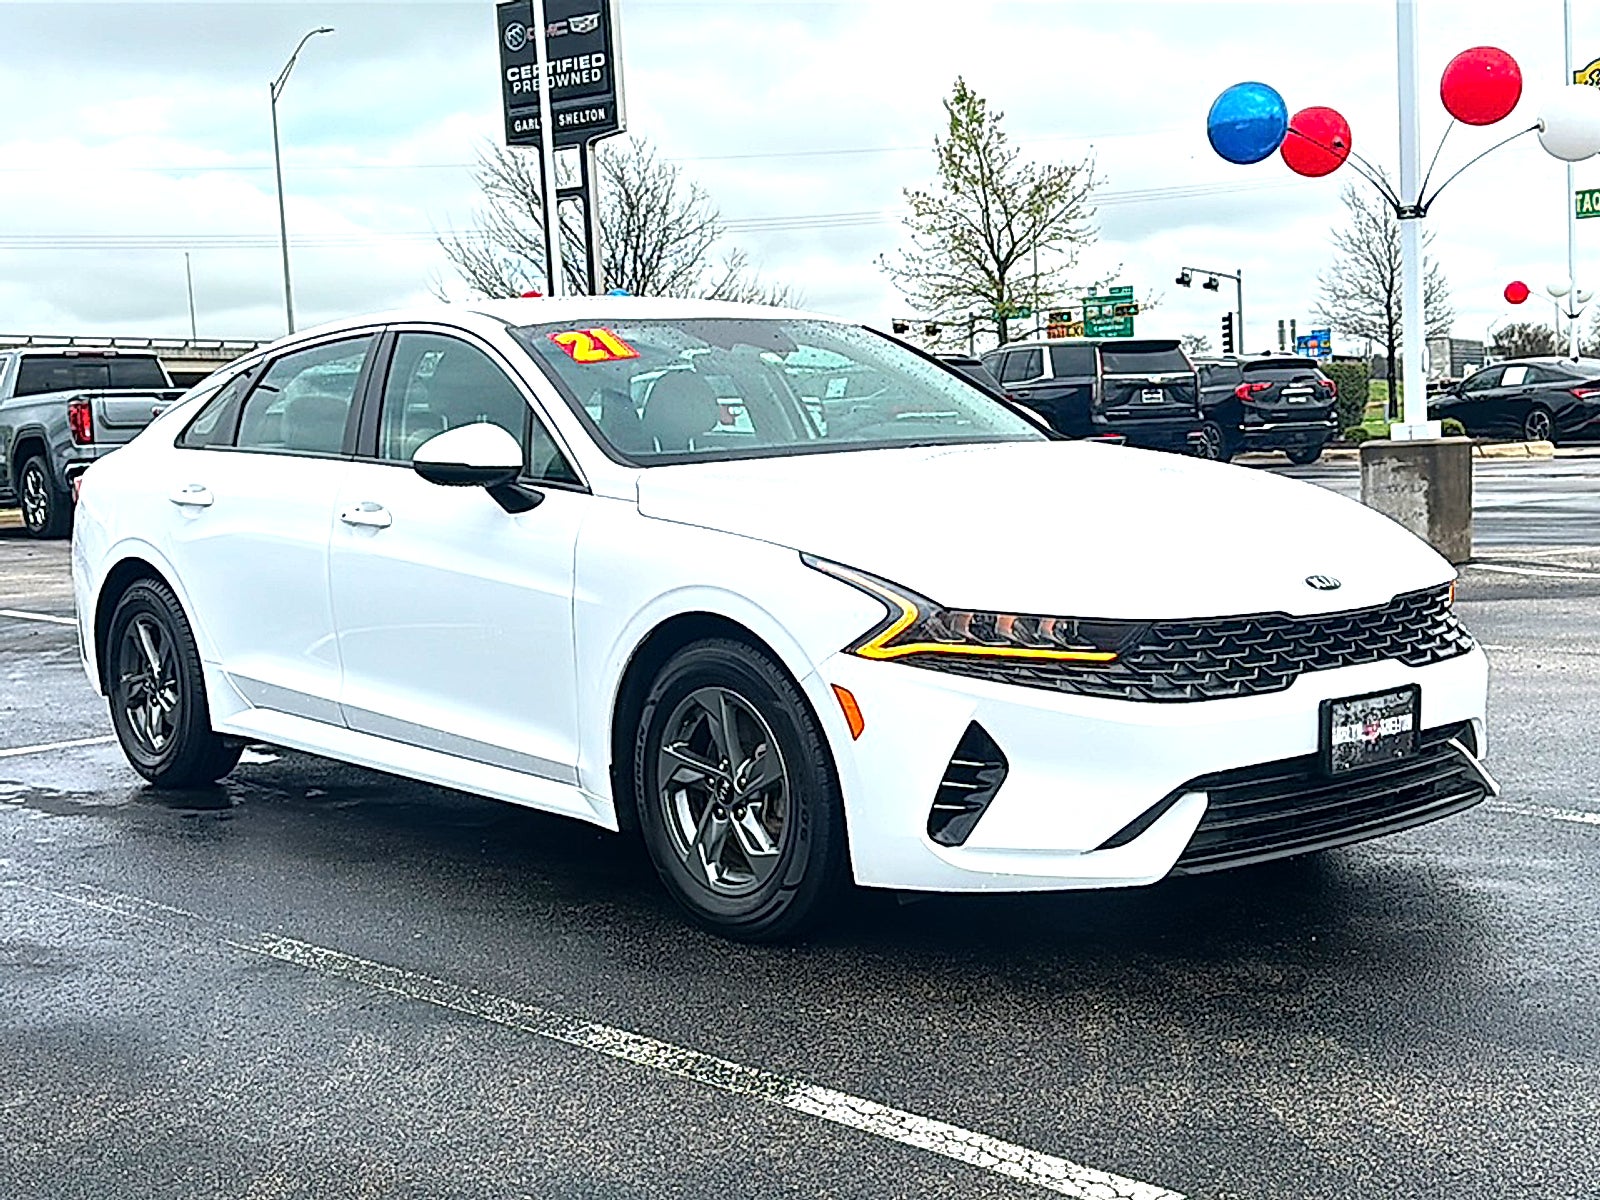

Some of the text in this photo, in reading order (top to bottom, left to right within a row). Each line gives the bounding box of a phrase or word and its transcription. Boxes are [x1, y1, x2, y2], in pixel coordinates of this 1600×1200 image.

[507, 53, 605, 81] CERTIFIED
[558, 108, 606, 126] SHELTON
[554, 328, 635, 361] 21
